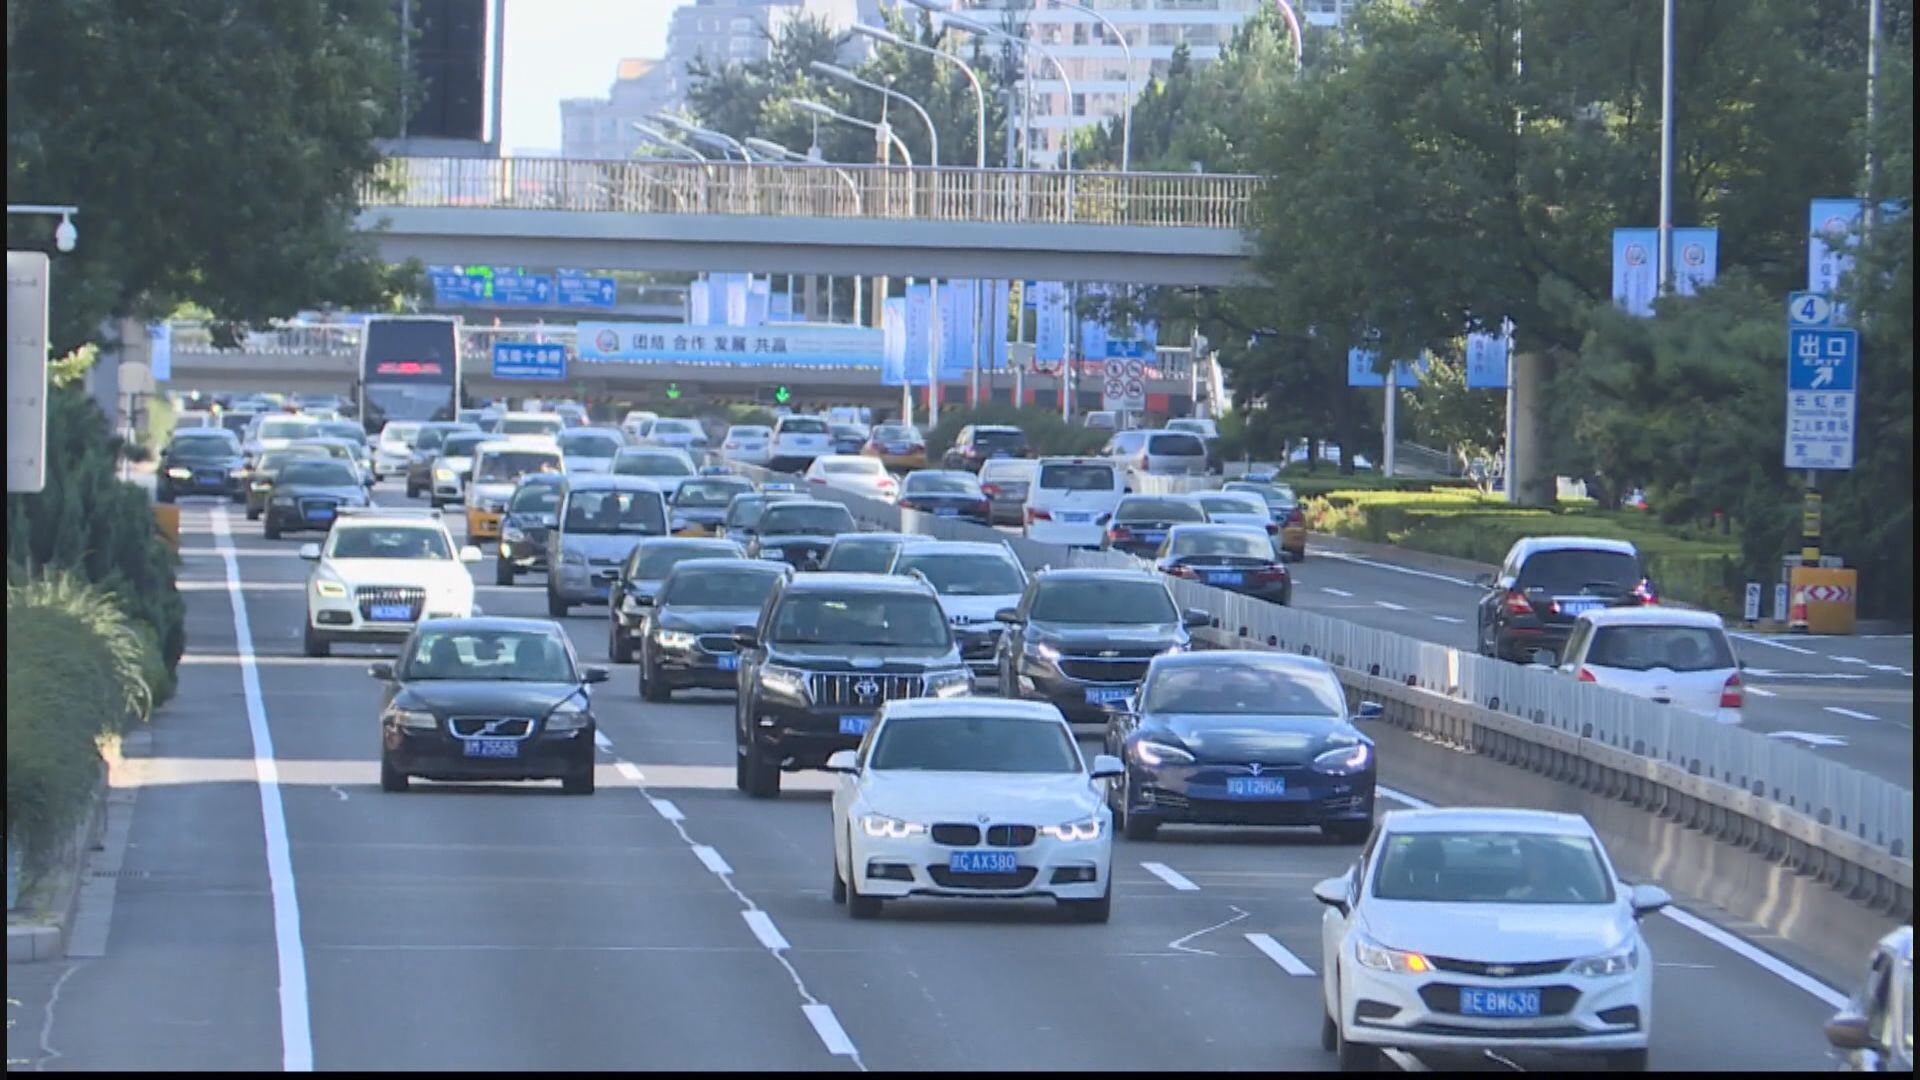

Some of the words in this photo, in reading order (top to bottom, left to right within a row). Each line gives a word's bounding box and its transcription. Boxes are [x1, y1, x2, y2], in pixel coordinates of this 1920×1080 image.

[1801, 299, 1816, 319] 4
[632, 333, 665, 351] 团结
[673, 333, 706, 351] 合作
[713, 334, 747, 352] 发展
[754, 335, 788, 354] 共赢
[1798, 334, 1847, 358] 出口
